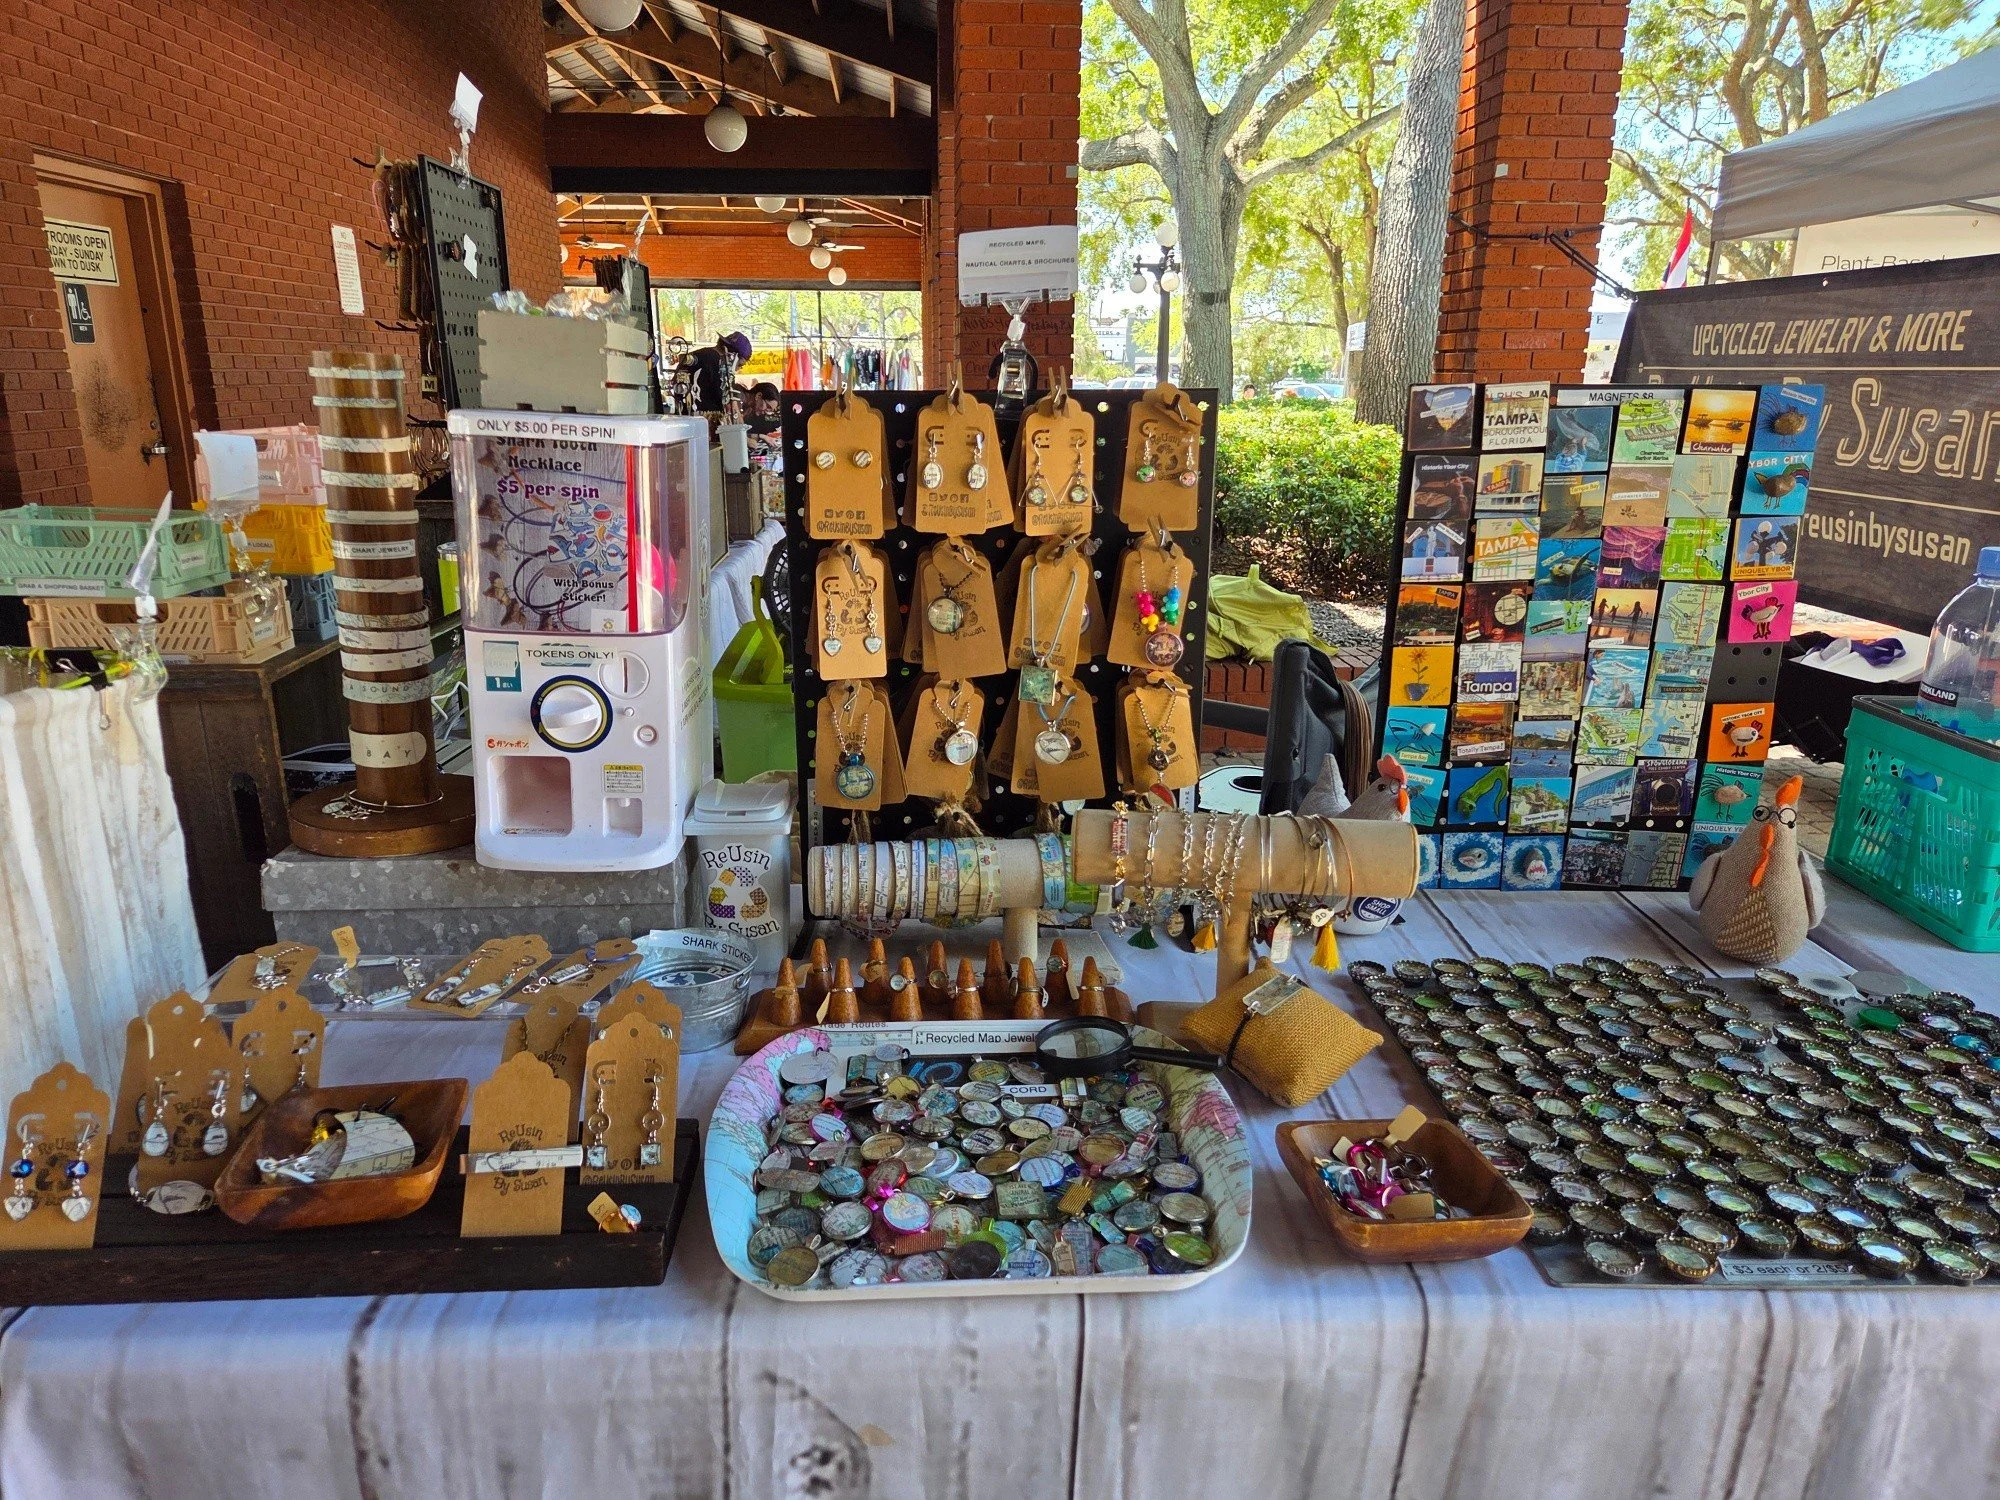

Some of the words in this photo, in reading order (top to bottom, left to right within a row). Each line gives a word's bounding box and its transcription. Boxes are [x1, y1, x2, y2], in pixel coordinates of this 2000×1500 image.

[84, 234, 107, 249] OPEN
[989, 240, 1024, 248] RECYCLED
[74, 248, 104, 261] SUNDAY
[67, 259, 79, 270] TO
[80, 261, 102, 273] DUSK
[1034, 257, 1075, 265] BROCHURES
[1692, 321, 1776, 356] UPCYCLED
[1773, 316, 1874, 355] JEWELRY
[1868, 315, 1893, 353] &
[1894, 309, 1973, 352] MORE
[424, 377, 435, 389] M
[1588, 392, 1641, 402] MAGNETS
[1641, 391, 1654, 400] $8
[1485, 412, 1539, 426] TAMPA
[477, 418, 513, 432] ONLY
[514, 421, 548, 434] $5.00
[551, 424, 578, 437] PER
[581, 426, 616, 439] SPIN!
[1834, 377, 2000, 483] Susan
[1488, 436, 1533, 446] FLORIDA
[1692, 442, 1733, 453] Clearwater
[507, 455, 582, 472] Necklace
[1749, 457, 1778, 468] YBOR
[1783, 454, 1808, 465] CITY
[497, 479, 520, 494] $5
[524, 484, 556, 499] per
[560, 484, 600, 501] spin
[1800, 509, 1972, 566] reusinbysusan
[1477, 535, 1528, 557] TAMPA
[1734, 566, 1770, 575] UNIQUELY
[1771, 565, 1791, 573] YBOR
[553, 578, 579, 588] With
[581, 579, 615, 589] Bonus
[561, 592, 606, 603] Sticker!
[1437, 588, 1456, 598] TAMPA
[1738, 589, 1755, 598] Ybor
[1755, 585, 1770, 593] City
[525, 649, 575, 659] TOKENS
[578, 650, 614, 660] ONLY!
[362, 685, 410, 693] SOUND
[1465, 680, 1513, 693] Tampa
[366, 749, 412, 759] BAY
[1458, 745, 1480, 754] Totally
[1716, 767, 1737, 775] Historic
[1749, 771, 1761, 779] City
[1695, 824, 1732, 832] UNIQUELY
[702, 844, 771, 870] ReUsin
[1365, 903, 1387, 915] SMALL
[1371, 899, 1391, 910] SHOP
[682, 935, 719, 951] SHARK
[926, 1033, 976, 1043] Recycled
[977, 1033, 1002, 1043] Map
[1009, 1085, 1047, 1094] CORD
[498, 1123, 543, 1142] ReUsin
[493, 1175, 511, 1196] By
[513, 1172, 549, 1192] Susan
[1732, 1264, 1754, 1275] $3
[1756, 1264, 1791, 1275] each
[1795, 1265, 1810, 1275] or
[1811, 1263, 1849, 1275] 2/$5
